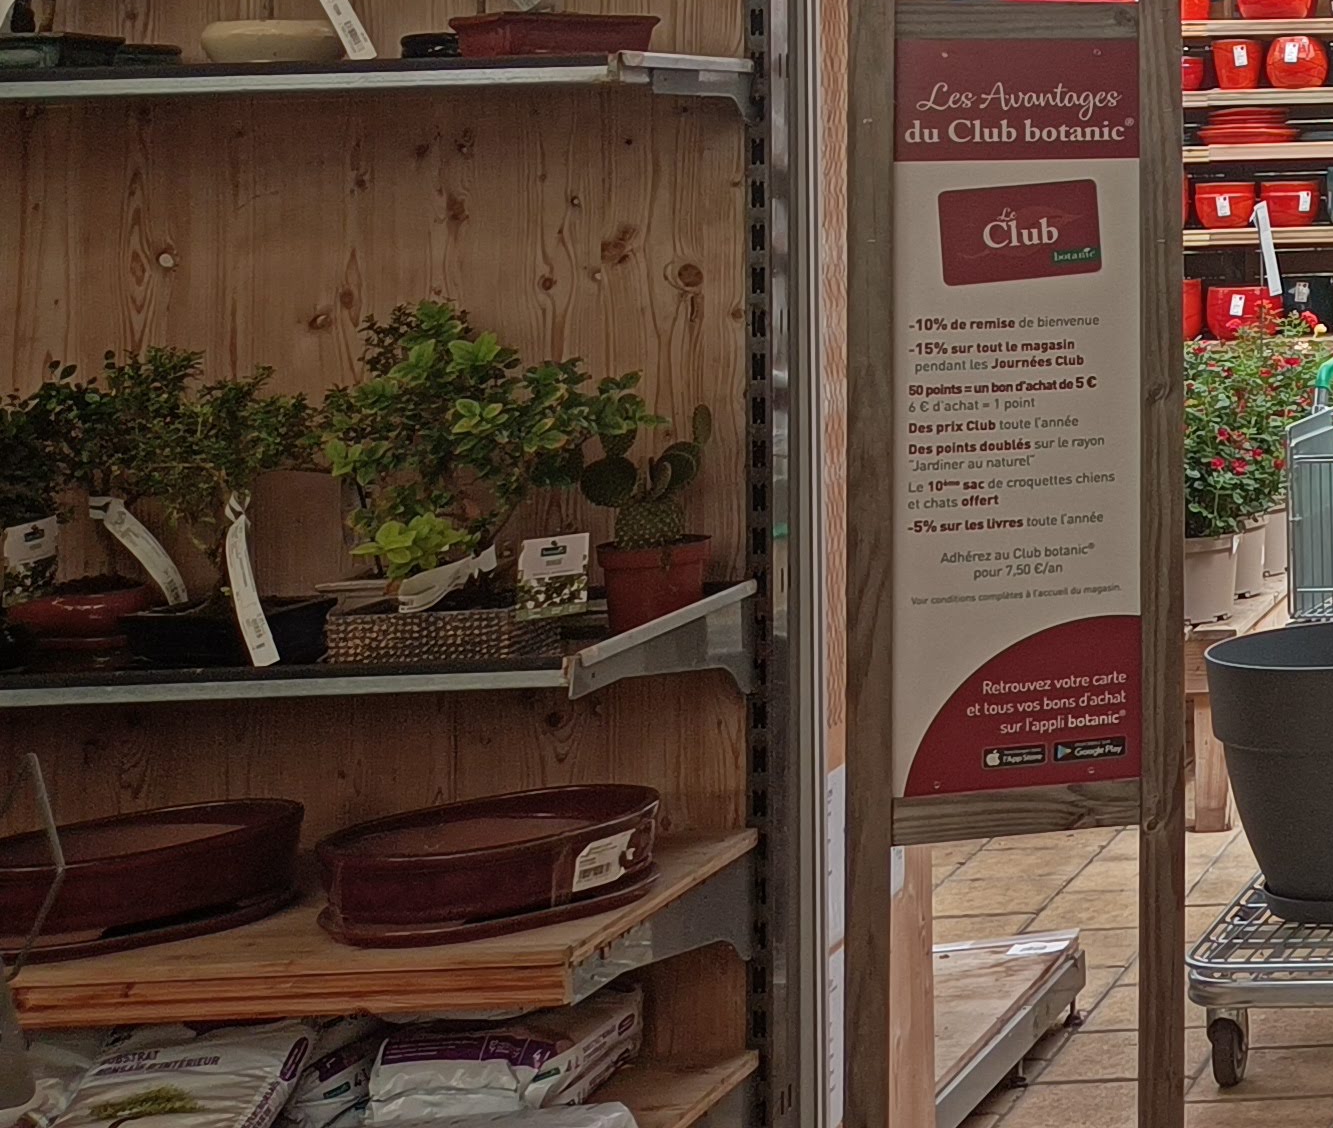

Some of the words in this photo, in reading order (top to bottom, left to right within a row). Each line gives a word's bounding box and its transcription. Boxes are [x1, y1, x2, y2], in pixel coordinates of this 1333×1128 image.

[916, 82, 977, 111] Les
[979, 82, 1122, 121] Avantages
[905, 119, 940, 143] du
[948, 119, 1017, 142] Club
[996, 206, 1018, 222] Le
[983, 217, 1058, 248] Club
[1053, 247, 1096, 263] botanic
[909, 318, 947, 331] -10%
[951, 319, 966, 330] de
[970, 318, 1015, 329] remise
[1019, 317, 1034, 328] de
[1037, 316, 1099, 327] bienvenue
[909, 342, 948, 355] -15%
[951, 345, 974, 354] sur
[977, 342, 1003, 353] tout
[1006, 341, 1018, 352] le
[1021, 339, 1074, 353] magasin
[915, 360, 966, 375] pendant
[970, 359, 988, 370] les
[991, 355, 1052, 369] Journées
[1055, 355, 1084, 366] Club
[909, 385, 924, 396] 50
[926, 384, 962, 398] points
[974, 385, 989, 393] un
[991, 382, 1013, 393] bon
[1015, 380, 1057, 391] d'achat
[1059, 379, 1074, 389] de
[1076, 376, 1084, 389] 5
[1086, 376, 1097, 388] €
[908, 402, 916, 413] 6
[920, 401, 929, 412] €
[933, 400, 979, 412] d'achat
[993, 399, 1001, 410] 1
[1004, 397, 1035, 412] point
[909, 423, 933, 433] Des
[936, 421, 963, 435] prix
[966, 420, 996, 431] Club
[999, 419, 1031, 430] toute
[1035, 415, 1079, 428] l'année
[909, 444, 933, 455] Des
[936, 442, 977, 456] points
[980, 438, 1031, 452] doublés
[1034, 440, 1055, 449] sur
[1058, 437, 1069, 448] le
[1072, 437, 1105, 449] rayon
[968, 460, 983, 469] au
[908, 482, 924, 493] Le
[963, 481, 984, 490] sac
[988, 478, 1003, 489] de
[1006, 476, 1072, 490] croquettes
[1075, 472, 1115, 484] chiens
[908, 499, 920, 510] et
[923, 497, 958, 509] chats
[961, 495, 999, 507] offert
[908, 520, 937, 533] -5%
[940, 522, 962, 532] sur
[965, 520, 984, 530] les
[987, 518, 1024, 529] livres
[1027, 516, 1057, 527] toute
[1061, 511, 1103, 525] l'année
[940, 551, 991, 564] Adhérez
[994, 552, 1010, 561] au
[1013, 547, 1041, 559] Club
[974, 568, 1003, 581] pour
[1005, 563, 1031, 577] 7,50
[1034, 562, 1063, 575] €/an
[911, 597, 929, 605] Voir
[930, 595, 976, 604] conditions
[978, 592, 1023, 602] complètes
[1025, 590, 1031, 598] à
[1070, 587, 1081, 595] du
[983, 680, 1051, 694] Retrouvez
[1054, 675, 1090, 688] votre
[1093, 671, 1127, 685] carte
[967, 703, 980, 716] et
[984, 702, 1014, 714] tous
[1017, 701, 1040, 712] vos
[1043, 697, 1076, 709] bons
[1079, 690, 1126, 706] d'achat
[1000, 723, 1022, 734] sur
[1026, 715, 1064, 733] l'appli
[1074, 746, 1104, 757] Google
[1105, 744, 1123, 755] Play
